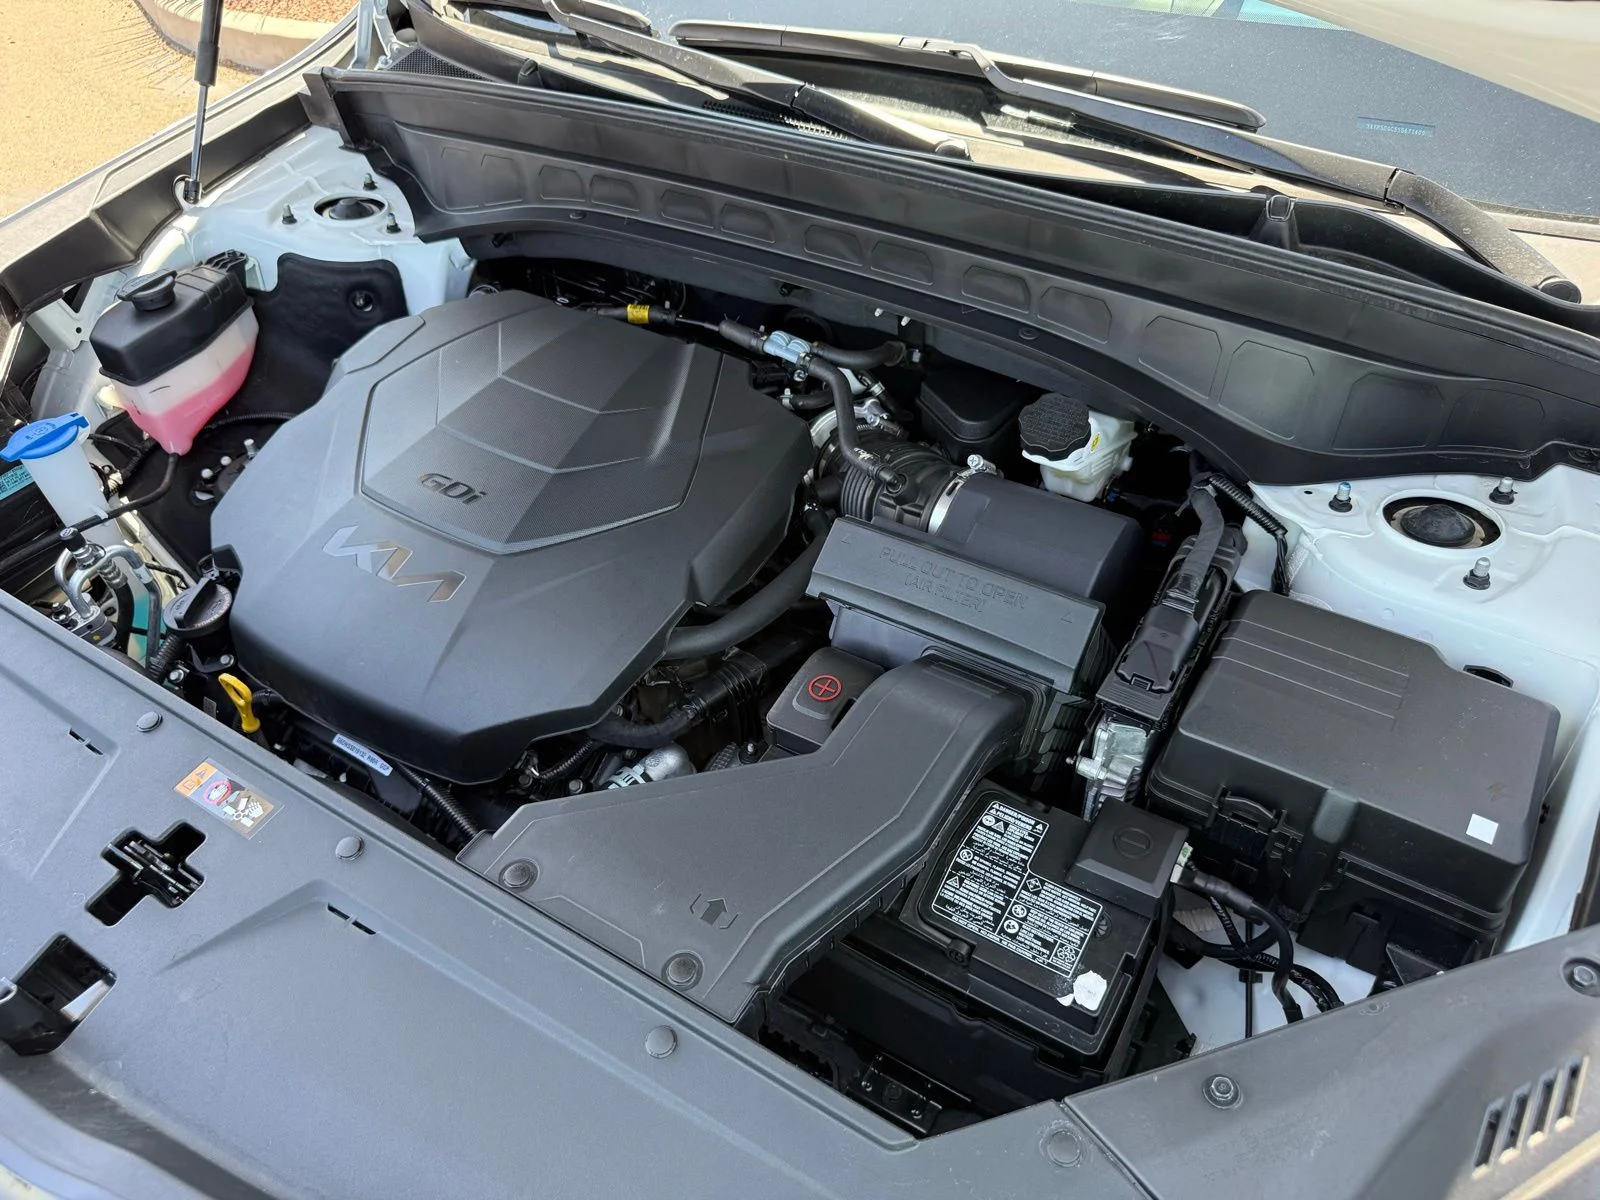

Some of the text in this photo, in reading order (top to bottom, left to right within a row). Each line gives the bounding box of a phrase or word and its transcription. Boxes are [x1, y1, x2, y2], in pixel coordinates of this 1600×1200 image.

[417, 473, 487, 505] GDi
[323, 525, 466, 602] KIA
[879, 546, 1029, 610] PULL OUT TO OPEN
